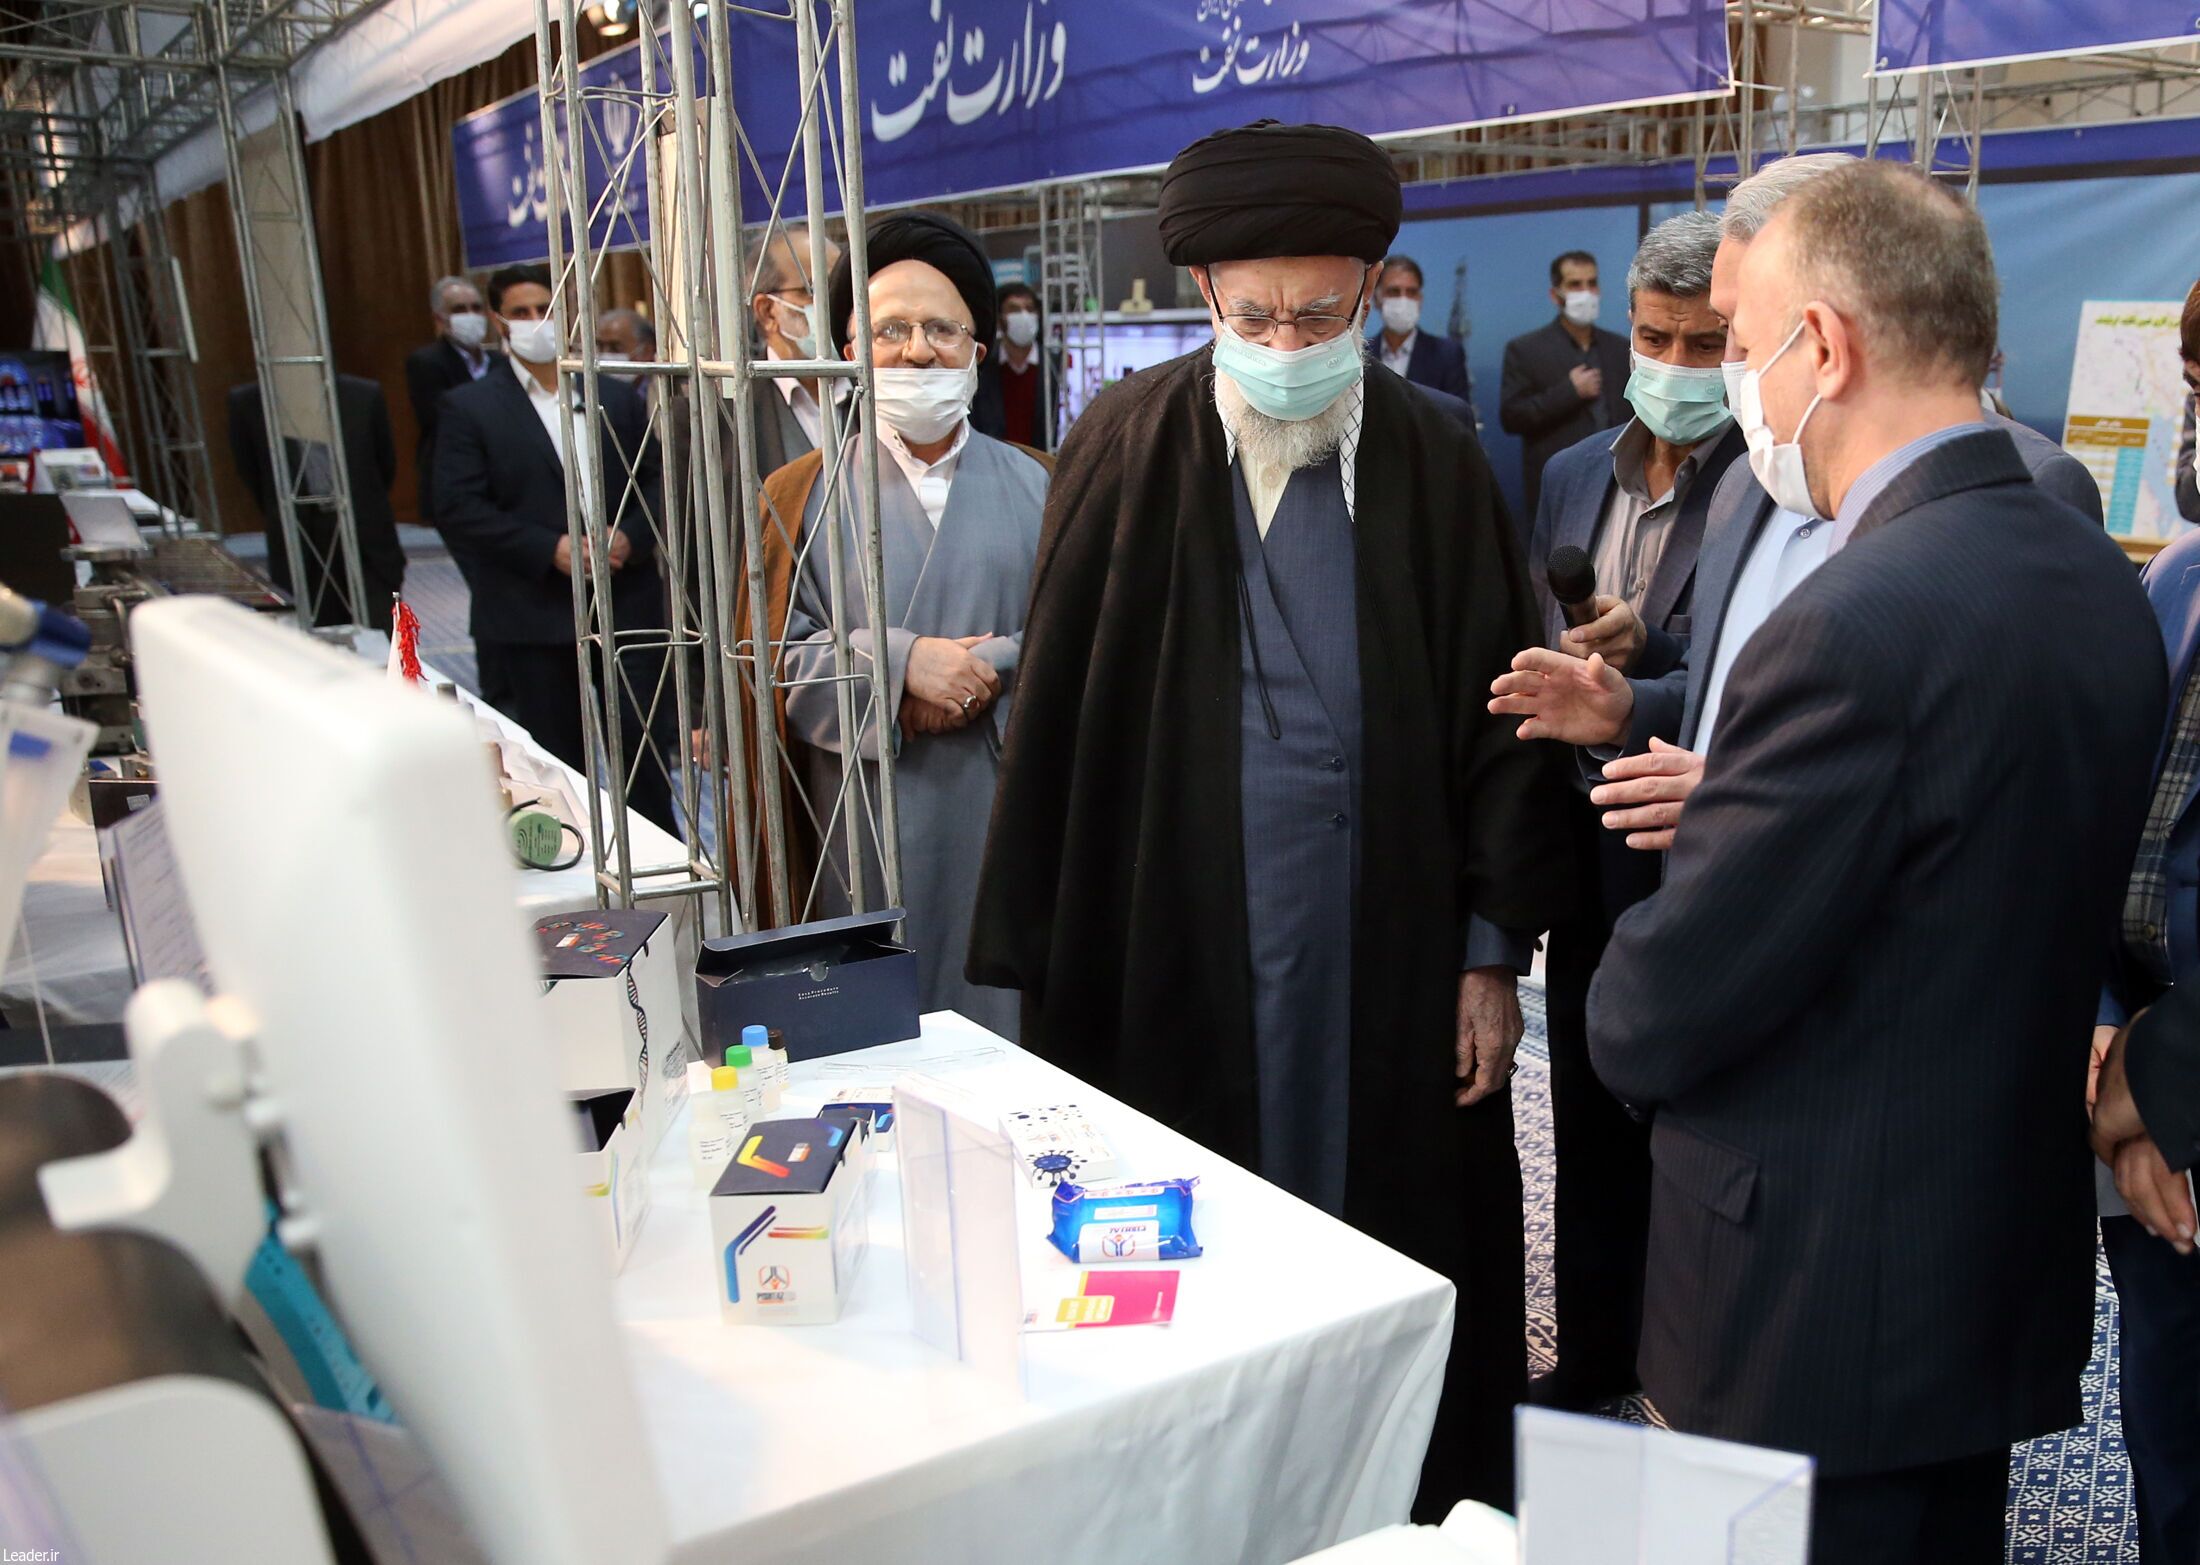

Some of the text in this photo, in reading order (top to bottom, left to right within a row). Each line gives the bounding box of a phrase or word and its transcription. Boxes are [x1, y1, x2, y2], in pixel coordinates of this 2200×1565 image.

[871, 0, 1067, 142] وزارت نفت
[1192, 15, 1310, 94] وزارت نفت
